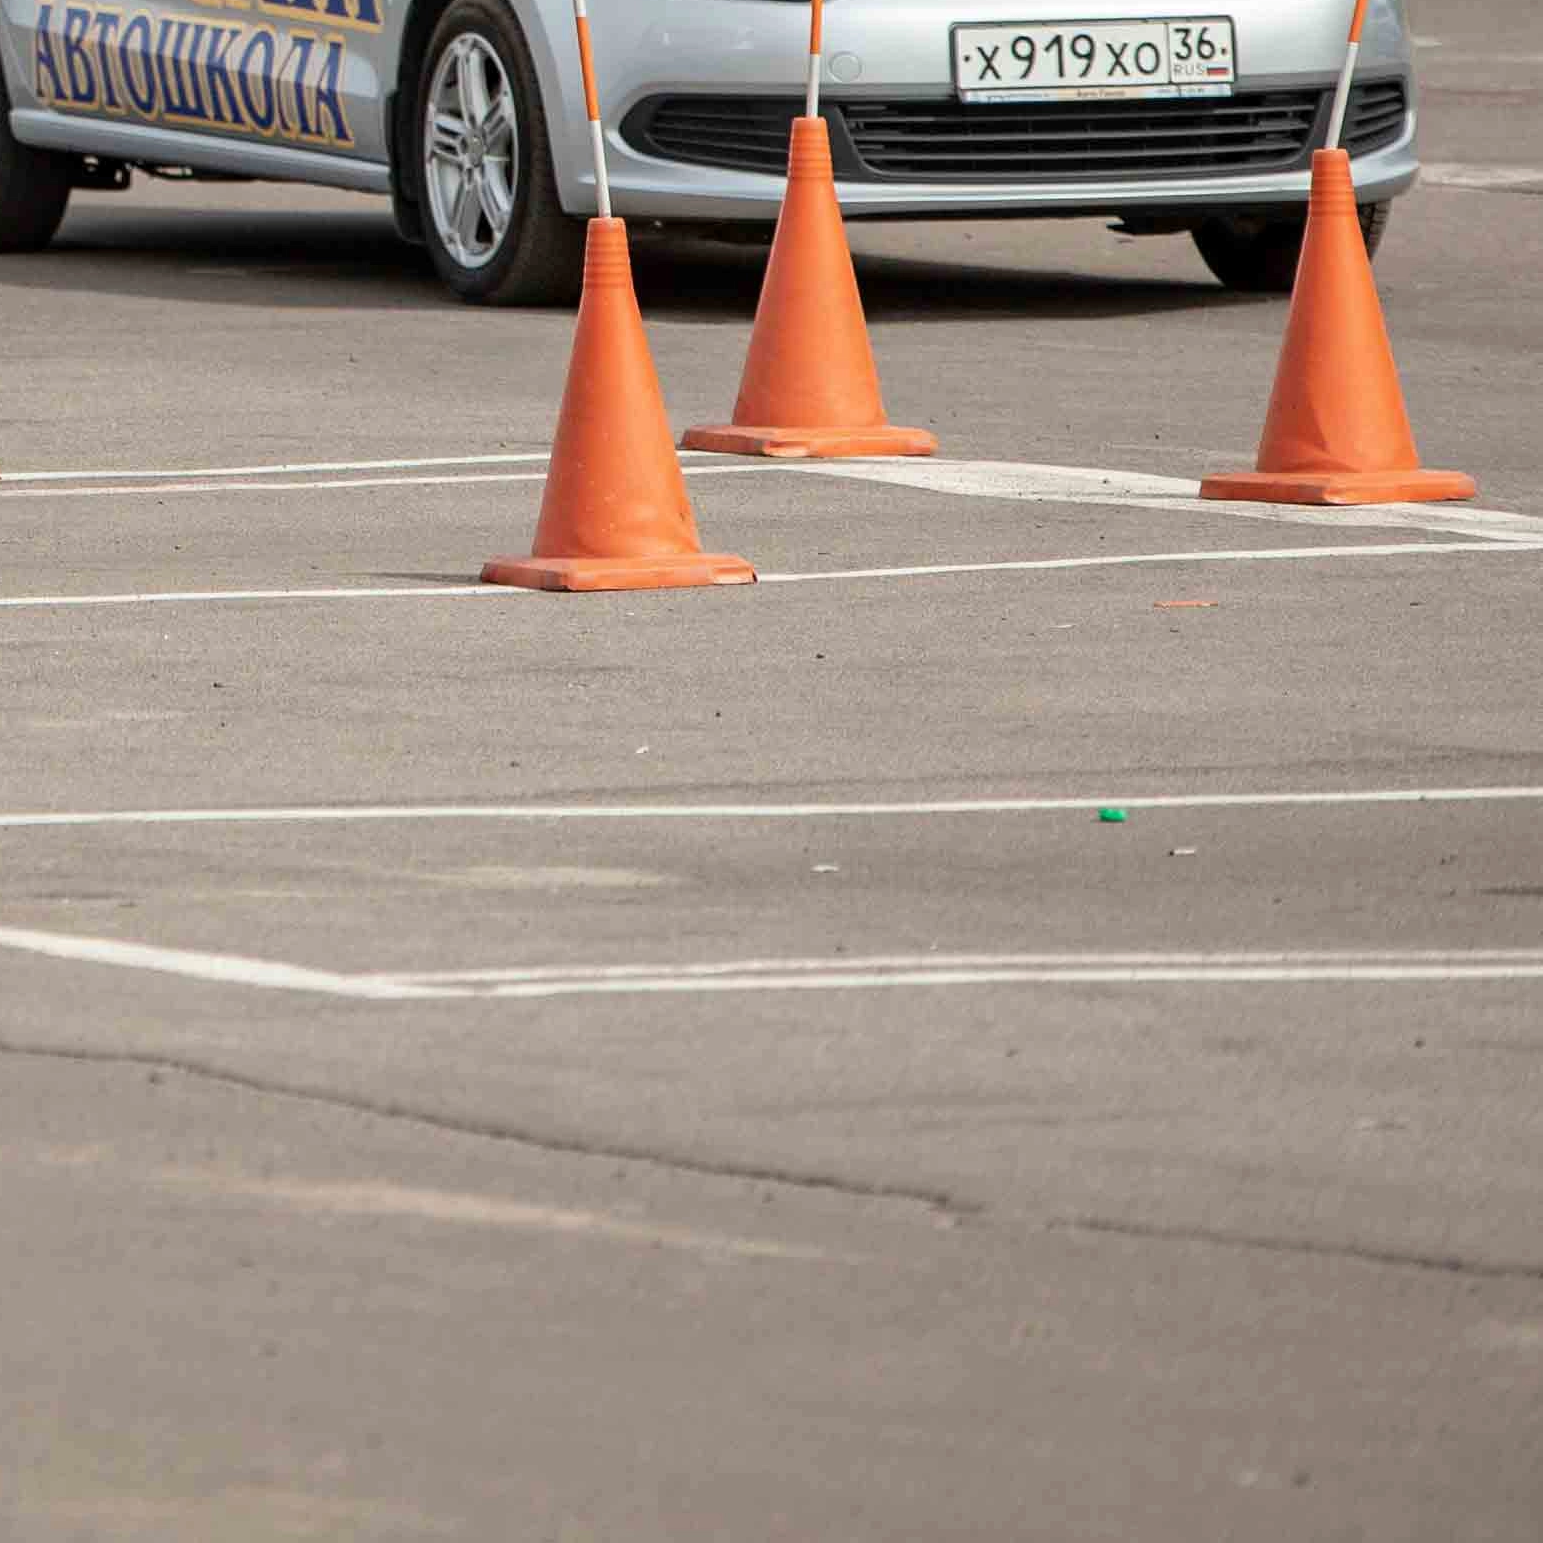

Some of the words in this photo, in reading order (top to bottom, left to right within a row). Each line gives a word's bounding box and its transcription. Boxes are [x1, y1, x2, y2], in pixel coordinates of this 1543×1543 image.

[1173, 26, 1216, 60] 36
[33, 1, 355, 145] АВТОШКОЛА
[1173, 64, 1205, 75] RUS
